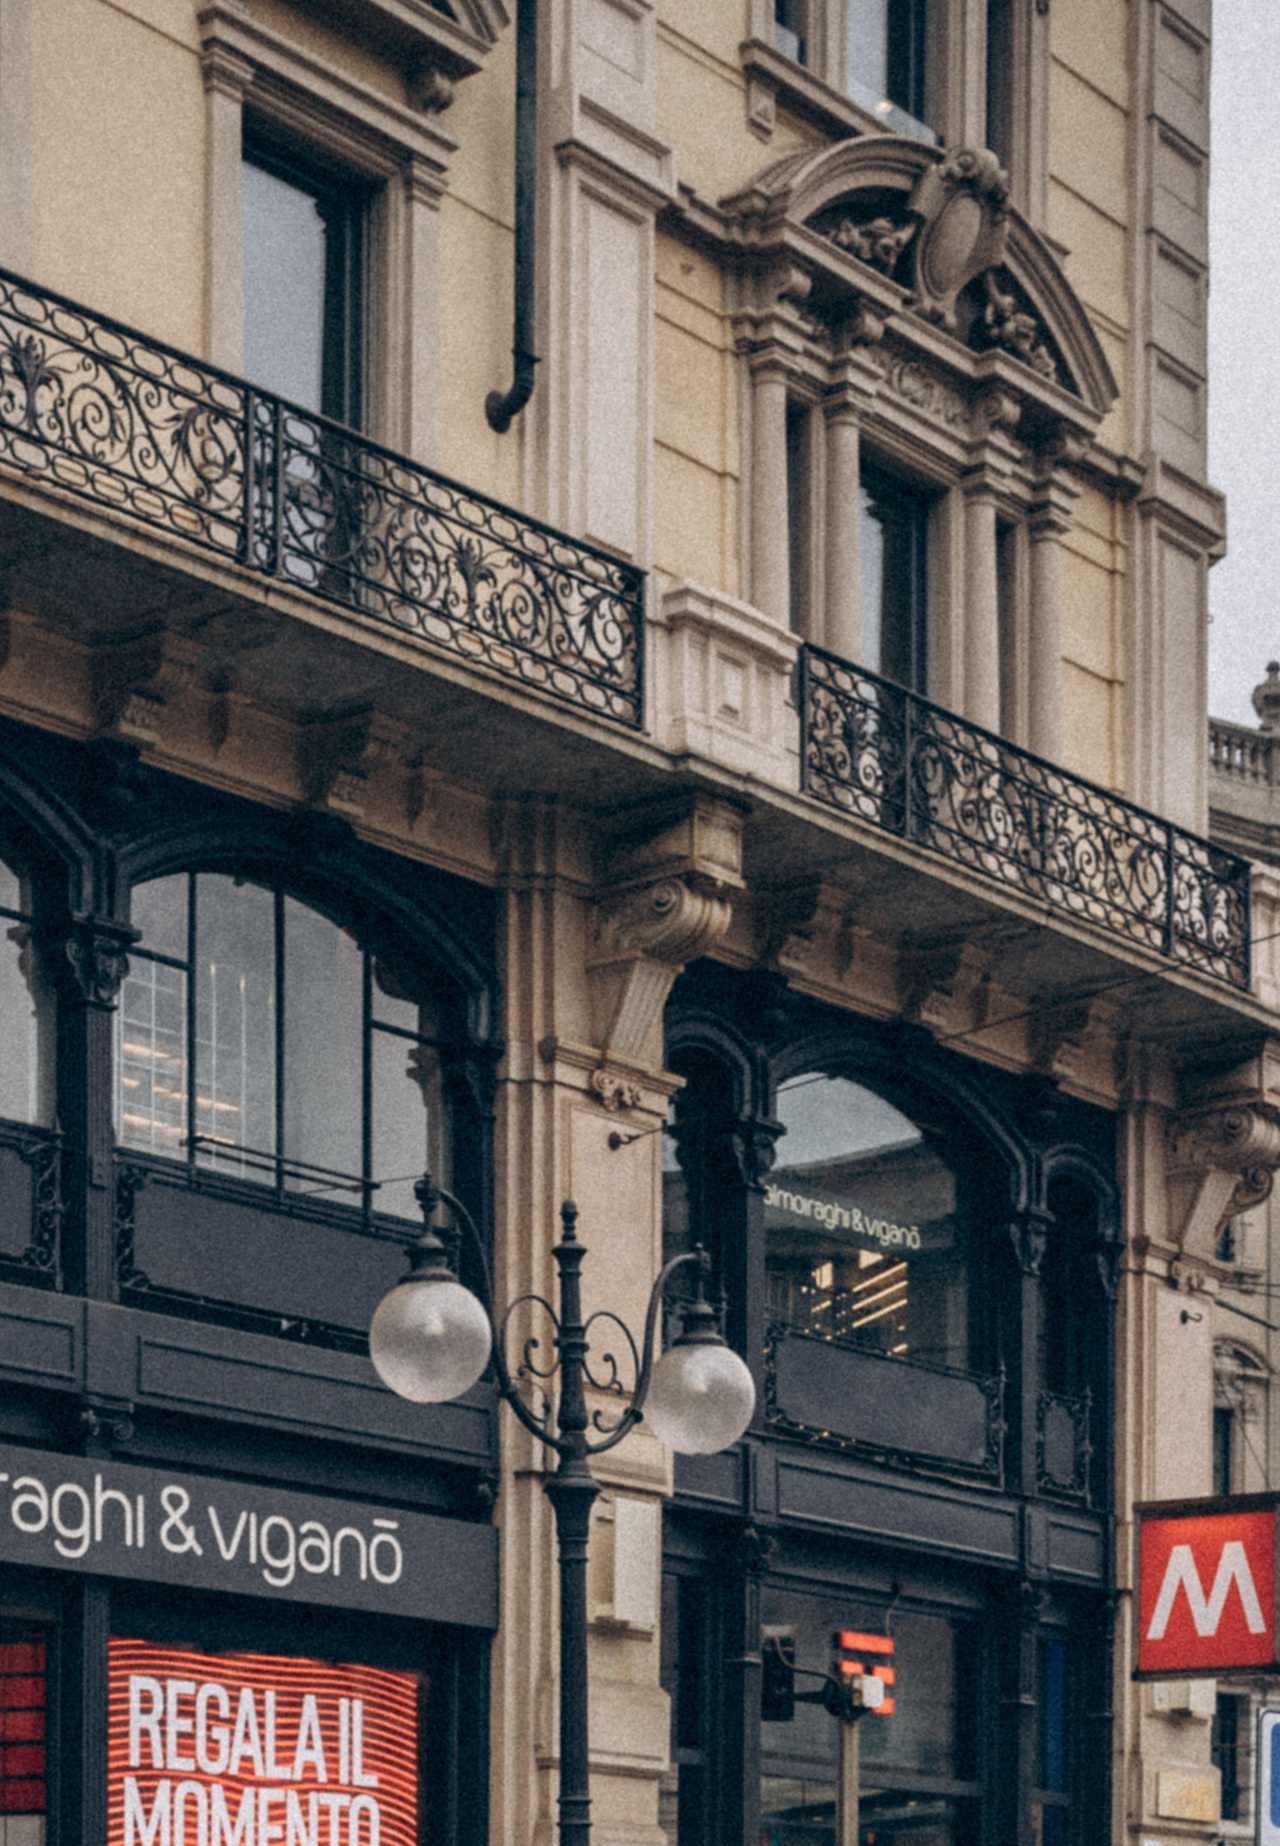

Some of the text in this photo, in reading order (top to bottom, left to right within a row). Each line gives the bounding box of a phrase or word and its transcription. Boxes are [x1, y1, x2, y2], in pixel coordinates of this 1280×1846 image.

[852, 1207, 866, 1234] &
[159, 1484, 204, 1557] &
[1146, 1540, 1267, 1640] M
[128, 1674, 379, 1788] REGALA IL
